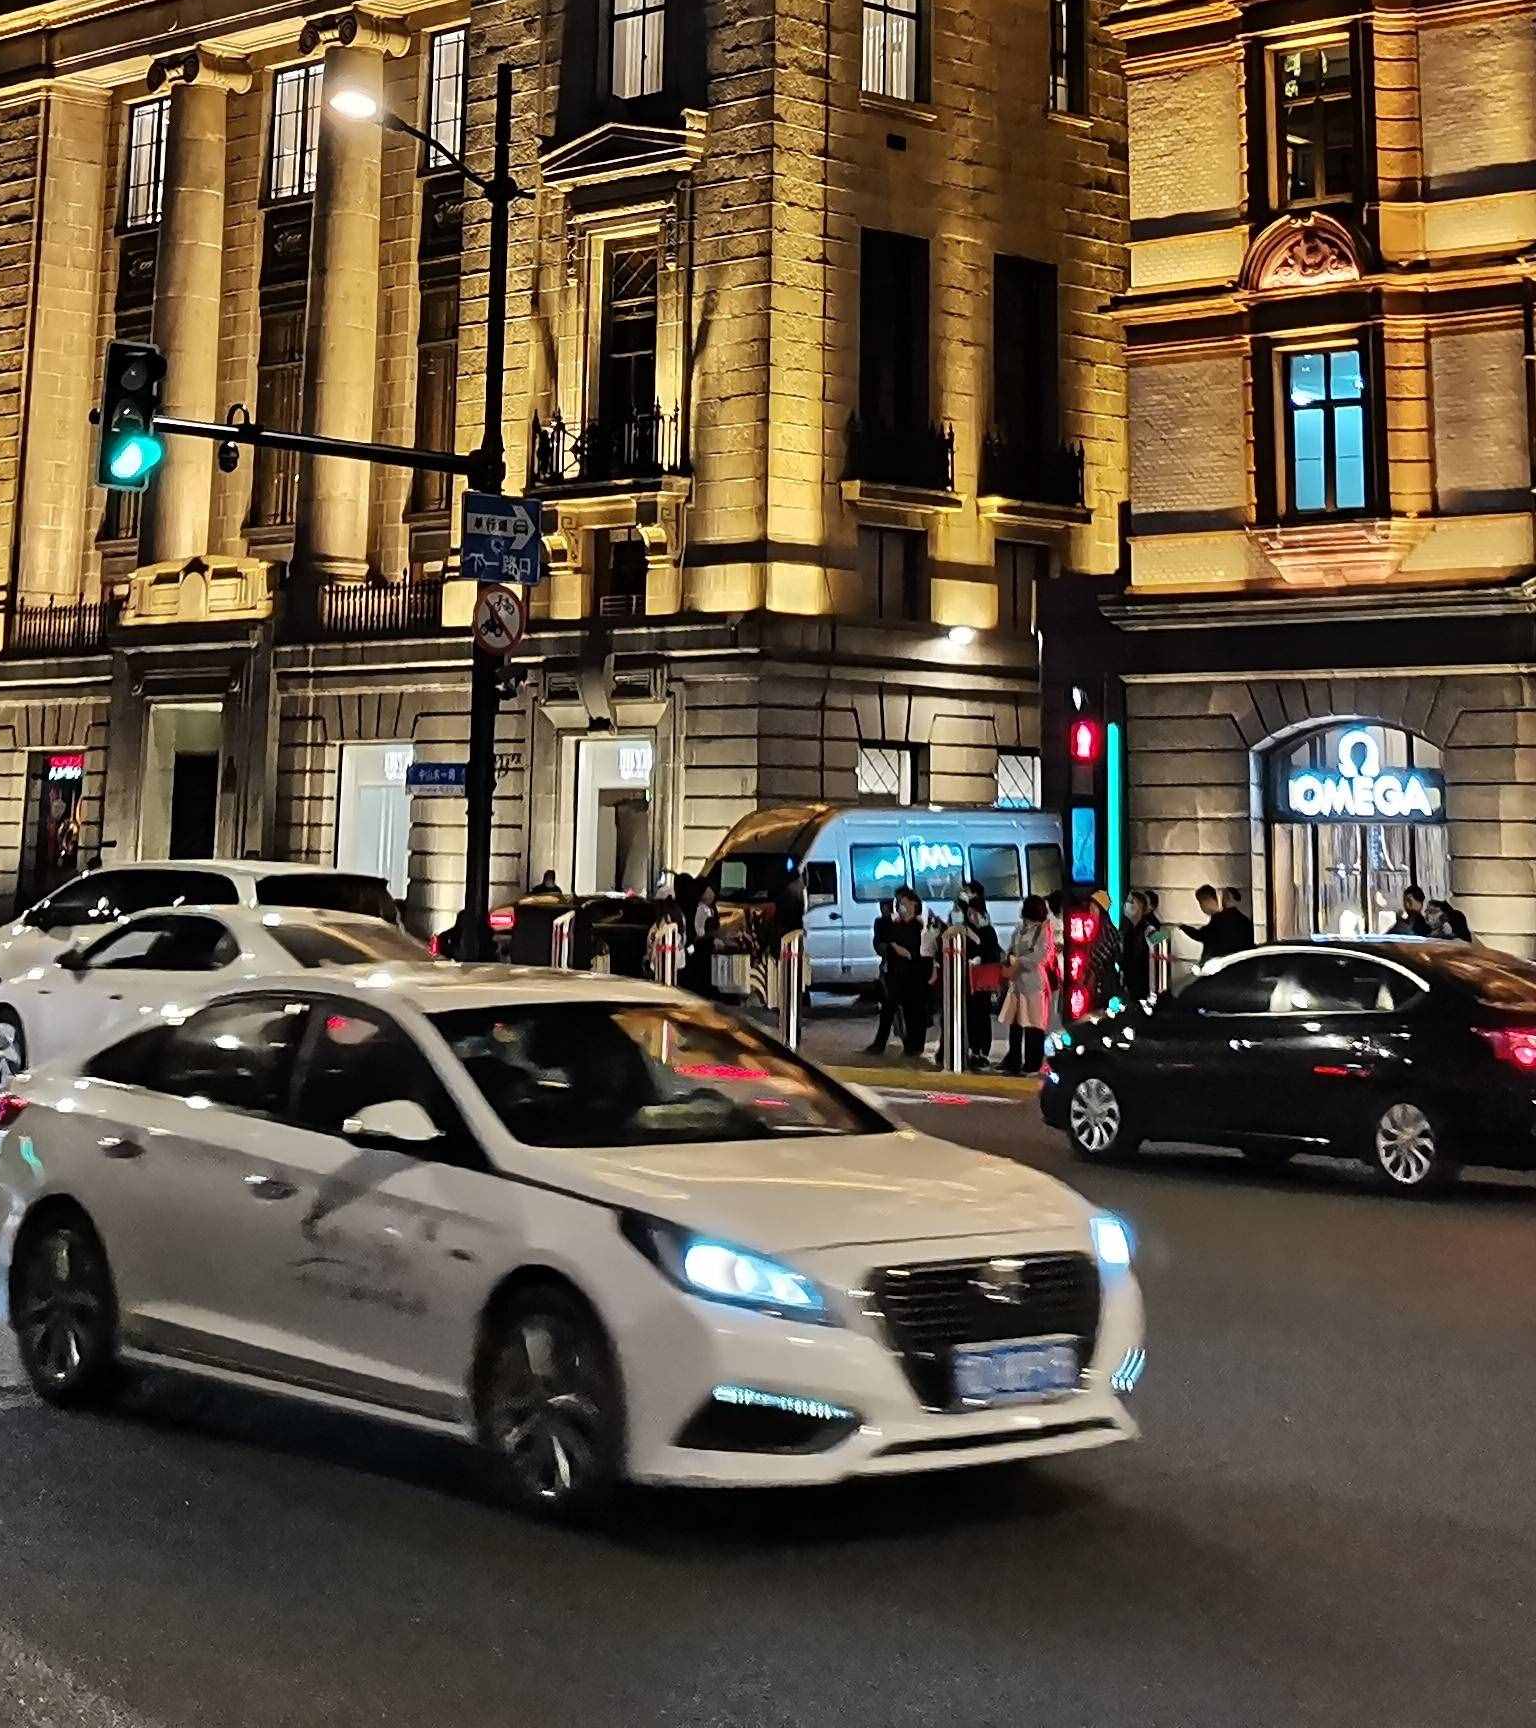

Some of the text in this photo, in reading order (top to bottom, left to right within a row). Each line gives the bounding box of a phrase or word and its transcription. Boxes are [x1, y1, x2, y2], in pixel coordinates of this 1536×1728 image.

[465, 553, 531, 581] 下一路口
[1289, 775, 1433, 817] OMEGA
